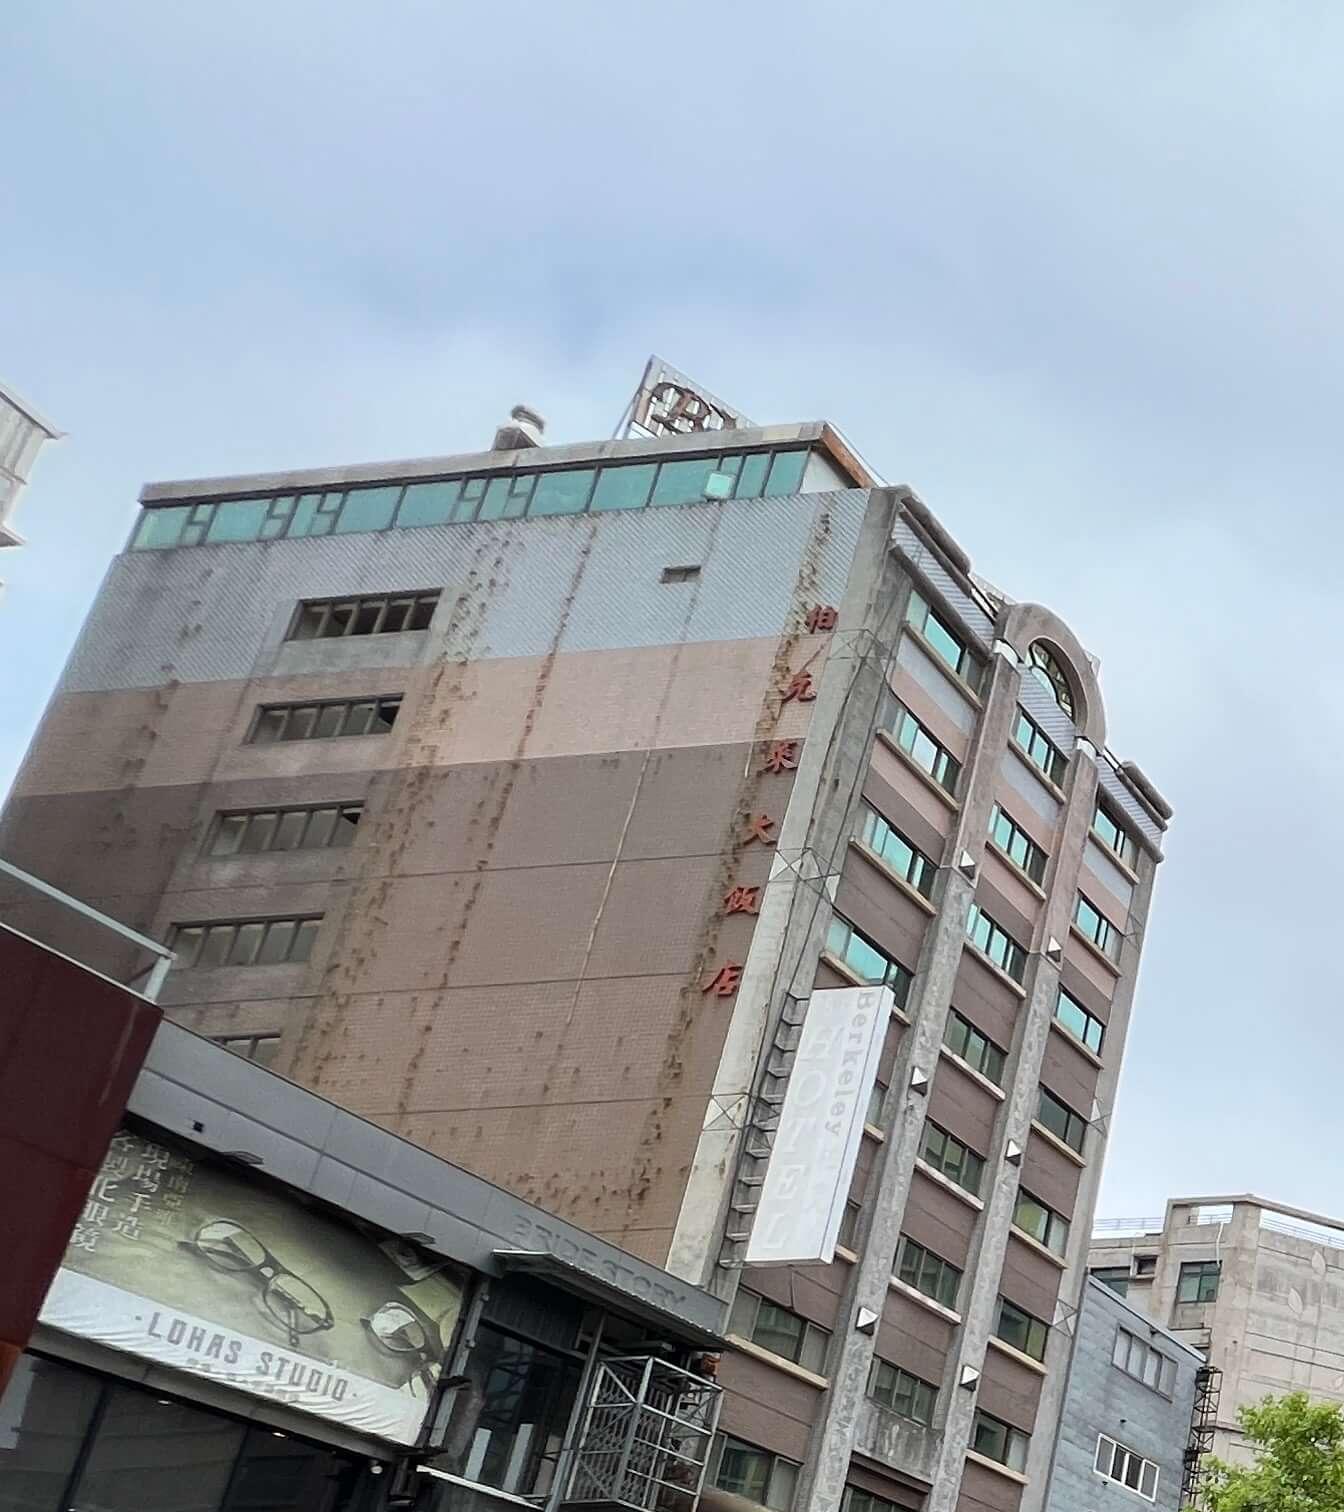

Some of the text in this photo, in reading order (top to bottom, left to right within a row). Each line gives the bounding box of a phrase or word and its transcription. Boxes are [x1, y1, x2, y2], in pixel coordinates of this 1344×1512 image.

[825, 991, 876, 1137] Berkeley
[147, 1312, 242, 1364] LOHAS
[256, 1351, 350, 1402] STUDIO
